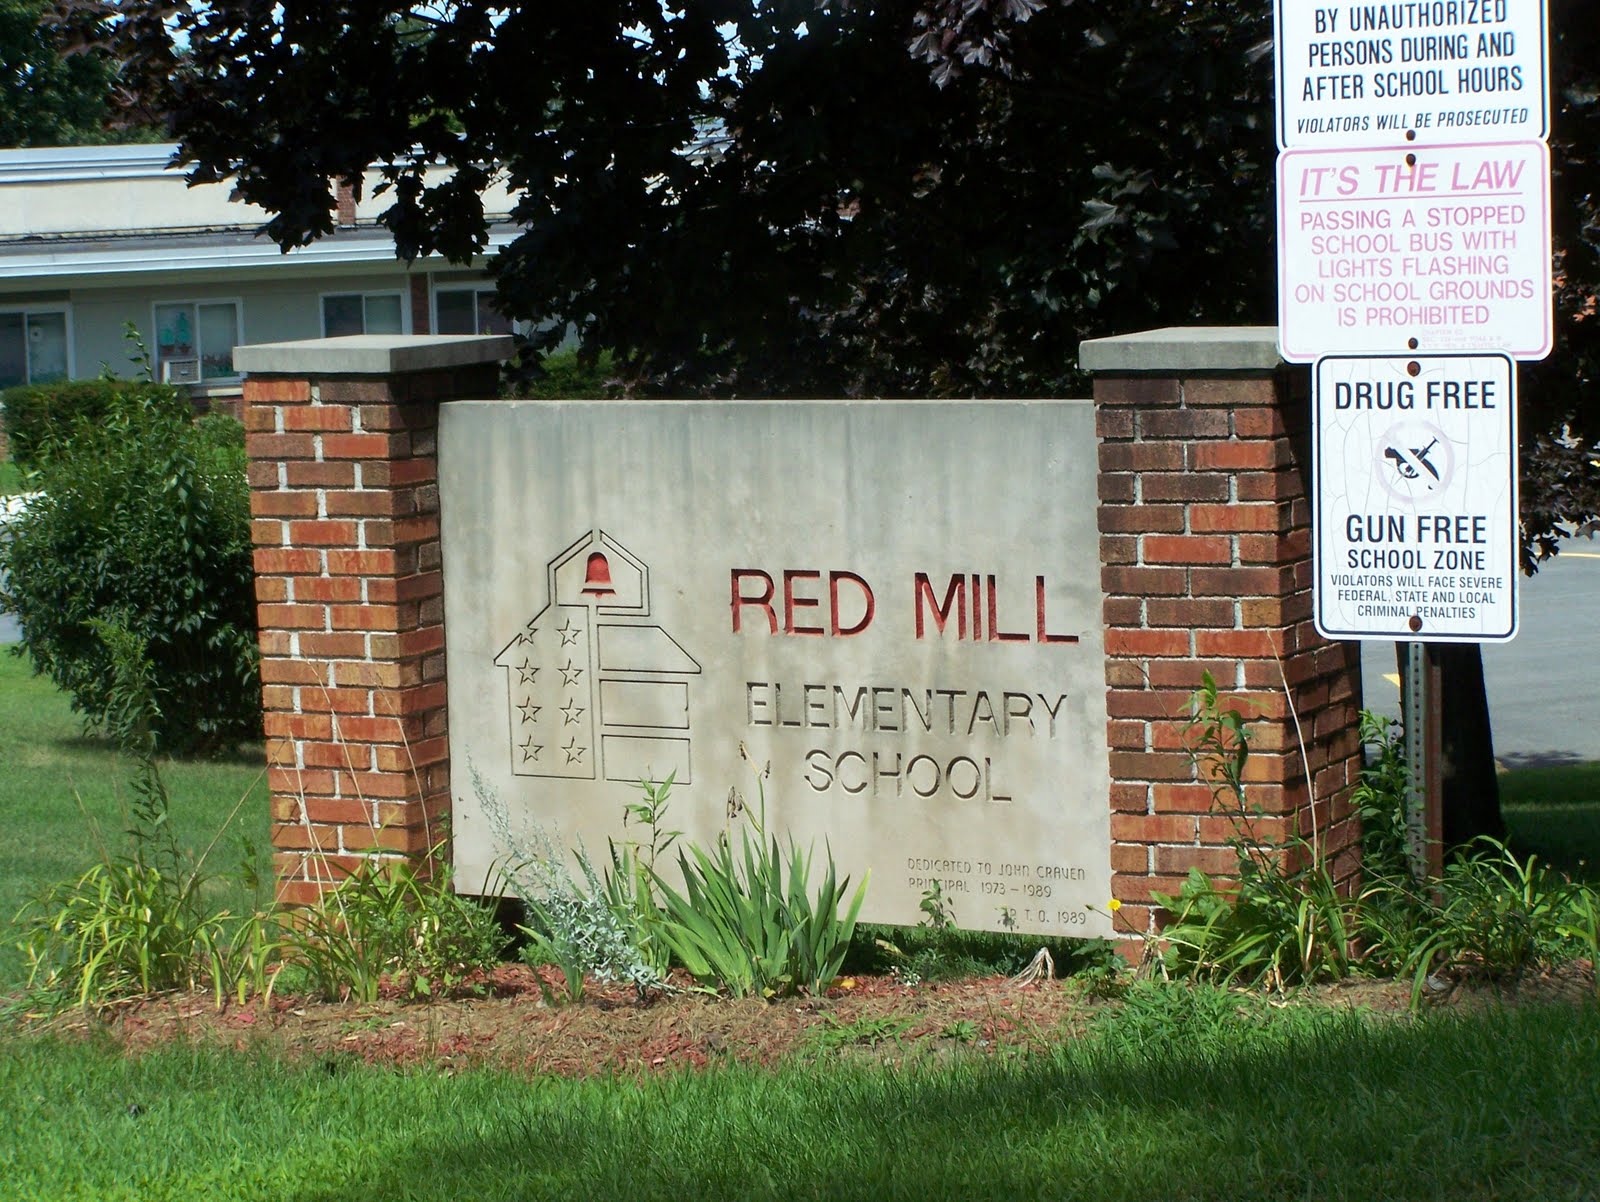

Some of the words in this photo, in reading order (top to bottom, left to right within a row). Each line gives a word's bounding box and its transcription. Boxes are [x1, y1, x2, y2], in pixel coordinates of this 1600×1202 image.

[1315, 8, 1338, 33] BY
[1350, 0, 1507, 31] UNAUTHORIZED
[1309, 39, 1393, 67] PERSONS
[1401, 34, 1468, 62] DURING
[1477, 31, 1515, 58] AND
[1302, 75, 1364, 101] AFTER
[1374, 70, 1449, 98] SCHOOL
[1458, 65, 1523, 93] HOURS
[1297, 116, 1370, 133] VIOLATORS
[1376, 113, 1408, 130] WILL
[1415, 112, 1432, 128] BE
[1437, 108, 1528, 127] PROSECUTED
[1300, 166, 1360, 196] IT'S
[1374, 163, 1439, 193] THE
[1451, 160, 1526, 191] LAW
[1300, 209, 1391, 231] PASSING
[1402, 209, 1416, 227] A
[1427, 205, 1525, 227] STOPPED
[1311, 234, 1400, 255] SCHOOL
[1410, 232, 1453, 252] BUS
[1463, 230, 1516, 250] WITH
[1318, 258, 1392, 279] LIGHTS
[1402, 255, 1509, 276] FLASHING
[1295, 284, 1324, 303] ON
[1333, 282, 1420, 302] SCHOOL
[1429, 279, 1534, 300] GROUNDS
[1338, 308, 1356, 327] IS
[1366, 305, 1489, 326] PROHIBITED
[1335, 381, 1414, 410] DRUG
[1426, 381, 1496, 409] FREE
[1346, 514, 1405, 543] GUN
[1417, 515, 1487, 544] FREE
[1347, 549, 1426, 570] SCHOOL
[1433, 550, 1485, 570] ZONE
[1331, 574, 1393, 587] VIOLATORS
[1396, 575, 1424, 588] WILL
[1428, 576, 1455, 588] FACE
[1459, 576, 1502, 589] SEVERE
[730, 568, 875, 638] RED
[914, 572, 1080, 643] MILL
[1395, 590, 1428, 603] STATE
[1431, 591, 1455, 603] AND
[1459, 592, 1495, 604] LOCAL
[1357, 604, 1411, 618] CRIMINAL
[1416, 606, 1476, 619] PENALTIES
[746, 681, 1067, 739] ELEMENTARY
[803, 748, 1013, 802] SCHOOL
[907, 858, 971, 874] DEDICATED
[977, 862, 992, 875] TO
[998, 863, 1030, 877] JOHN
[1036, 865, 1086, 881] CRAVEN
[1057, 911, 1087, 925] 1989
